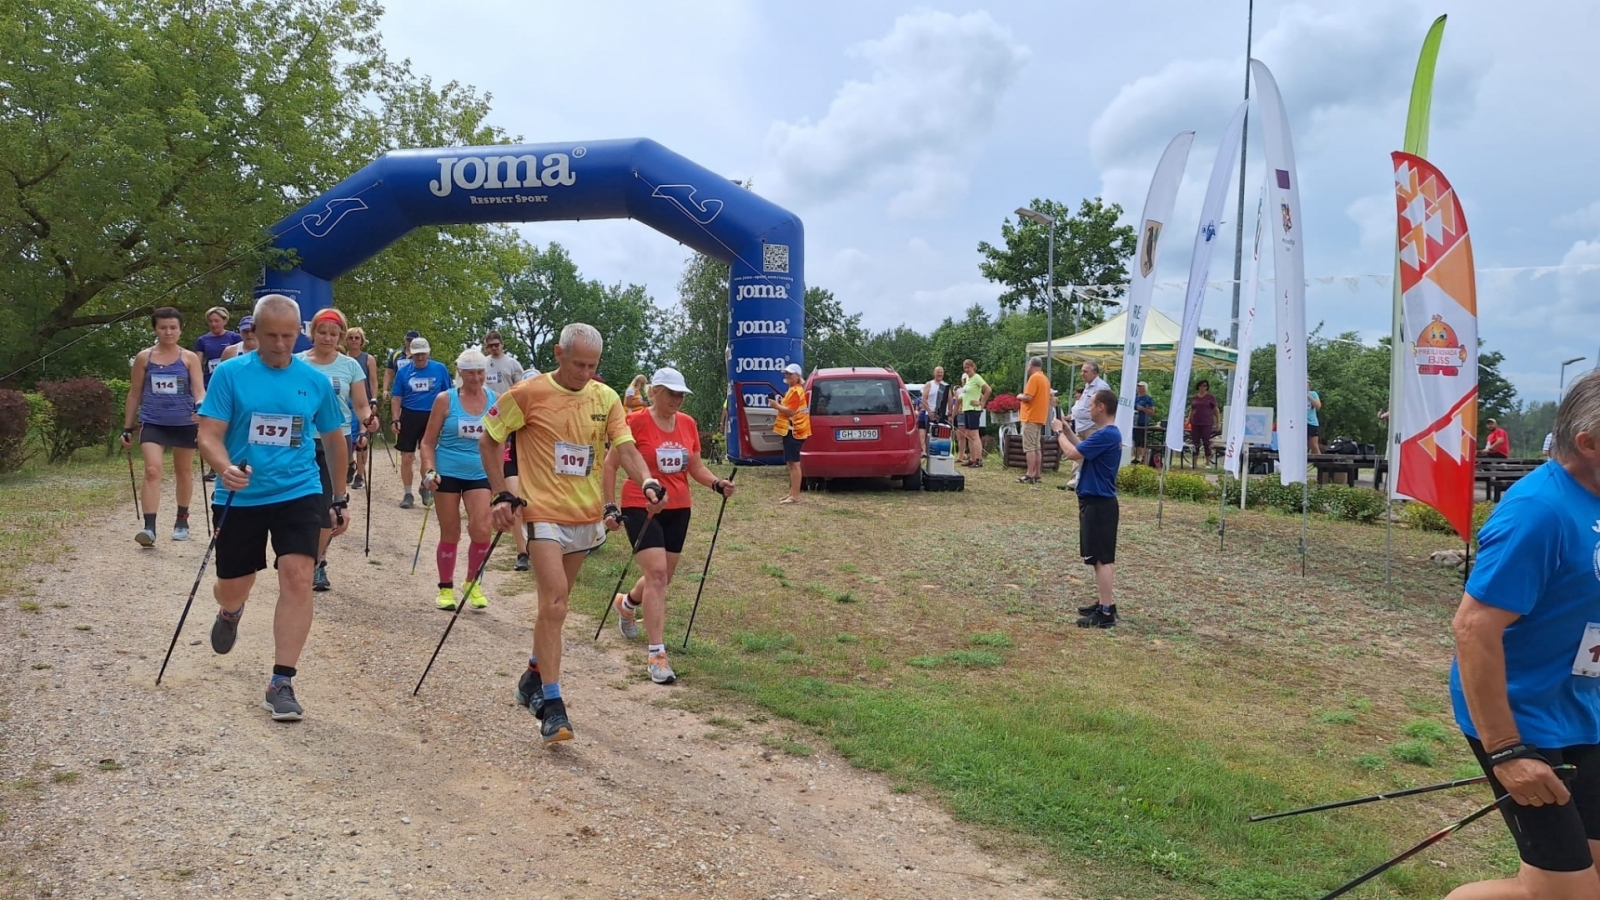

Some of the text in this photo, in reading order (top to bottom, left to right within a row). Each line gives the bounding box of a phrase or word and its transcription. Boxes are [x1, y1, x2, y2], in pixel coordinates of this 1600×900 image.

[515, 194, 549, 204] SPORT
[1428, 355, 1450, 365] BJSS
[155, 381, 174, 389] 114
[256, 424, 288, 438] 137
[462, 425, 484, 434] 134
[560, 454, 585, 468] 101
[660, 457, 681, 467] 128
